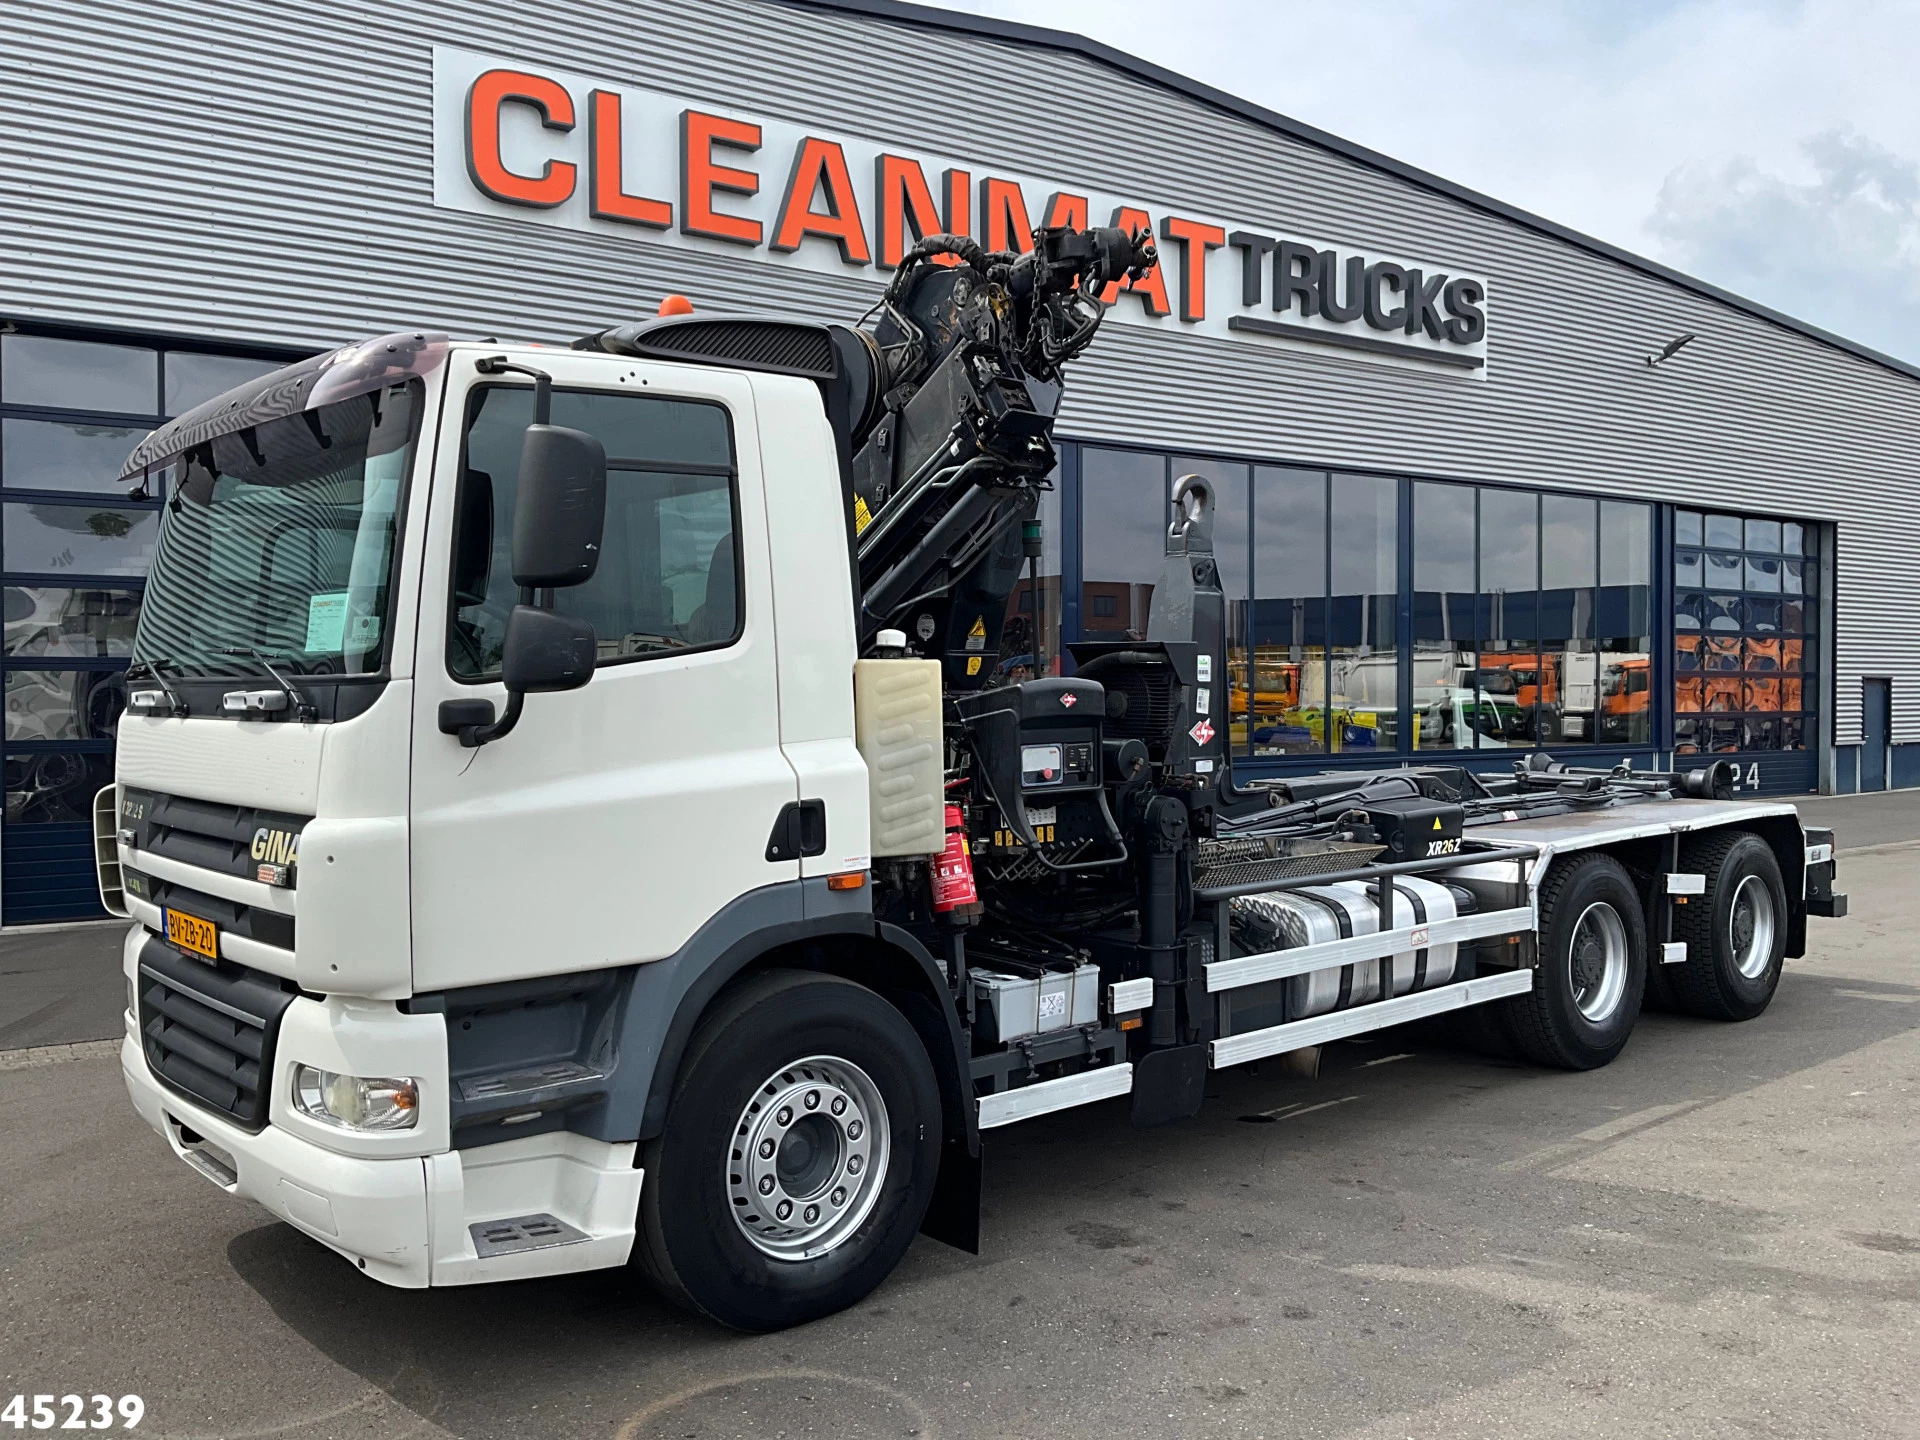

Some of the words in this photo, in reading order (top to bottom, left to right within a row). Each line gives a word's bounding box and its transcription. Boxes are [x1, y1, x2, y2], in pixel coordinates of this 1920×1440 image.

[464, 69, 1226, 323] CLEANMAT
[1228, 230, 1485, 345] TRUCKS
[1426, 838, 1462, 857] XR26Z
[169, 913, 213, 953] BV-ZB-20
